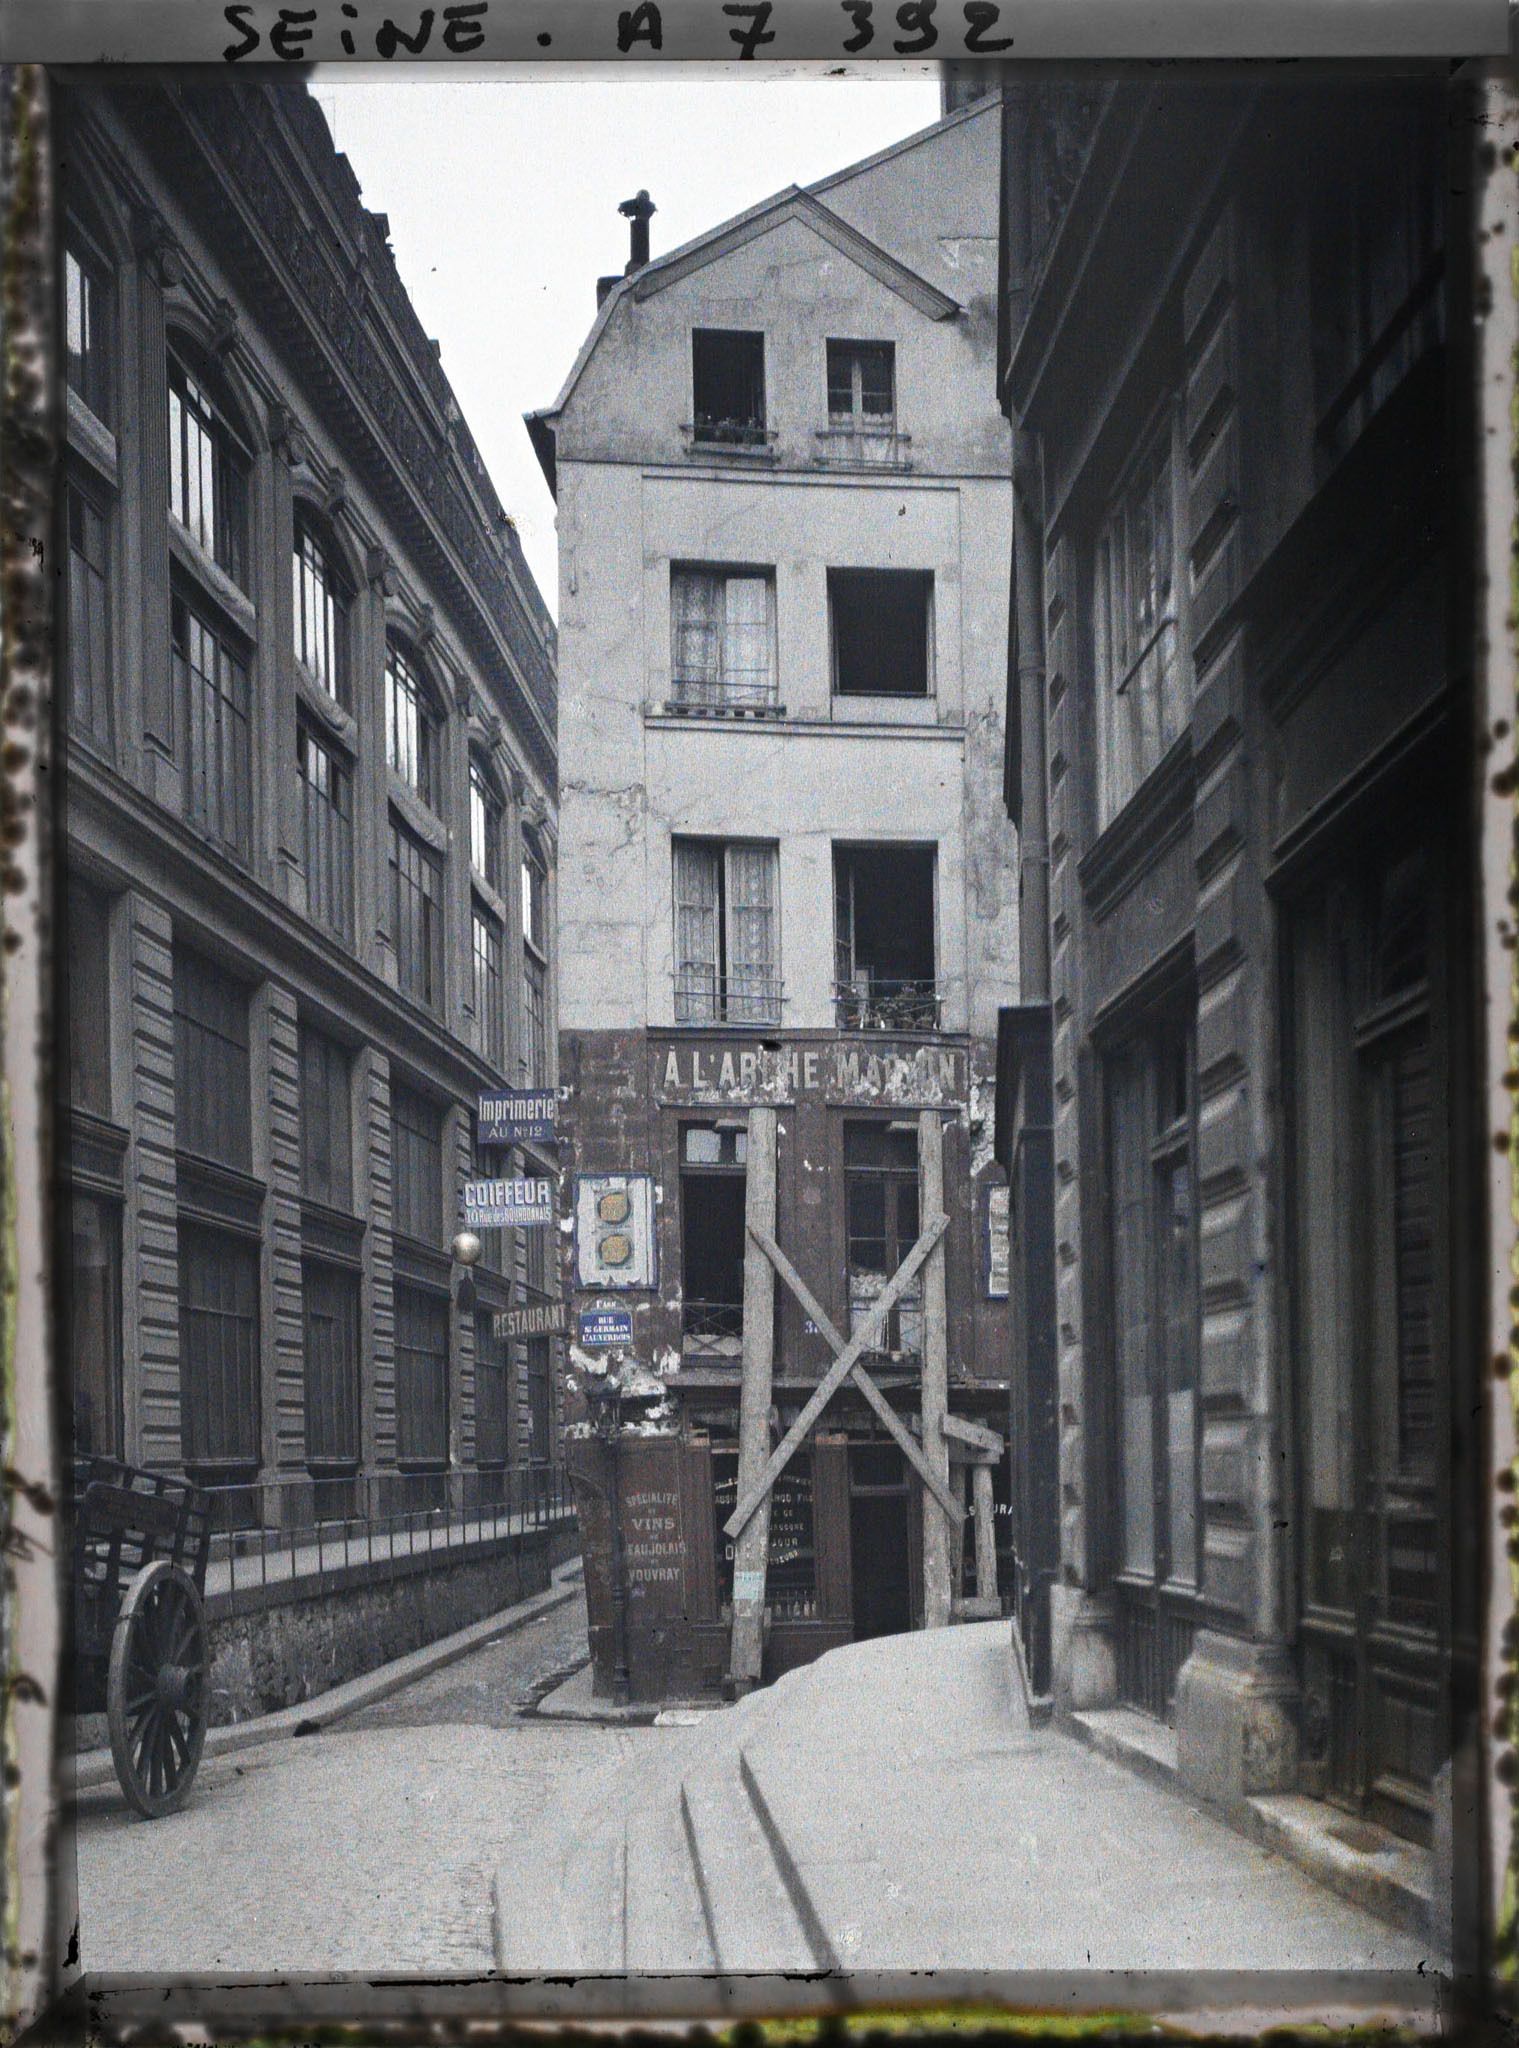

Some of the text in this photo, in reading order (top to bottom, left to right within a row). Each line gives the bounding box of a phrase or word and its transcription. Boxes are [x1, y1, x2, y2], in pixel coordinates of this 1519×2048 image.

[617, 1, 663, 53] A
[722, 1, 776, 60] 7
[693, 1051, 819, 1089] L'ARHE
[479, 1094, 554, 1127] Imprimerie
[489, 1126, 508, 1138] AU
[464, 1180, 550, 1207] COIFFEUR
[493, 1304, 566, 1338] RESTAURANT
[593, 1325, 628, 1333] GERMAIN
[598, 1316, 614, 1325] RUE
[631, 1518, 676, 1531] VINS
[627, 1542, 686, 1556] EAUJOLAIS
[628, 1567, 681, 1584] VOUVRAY
